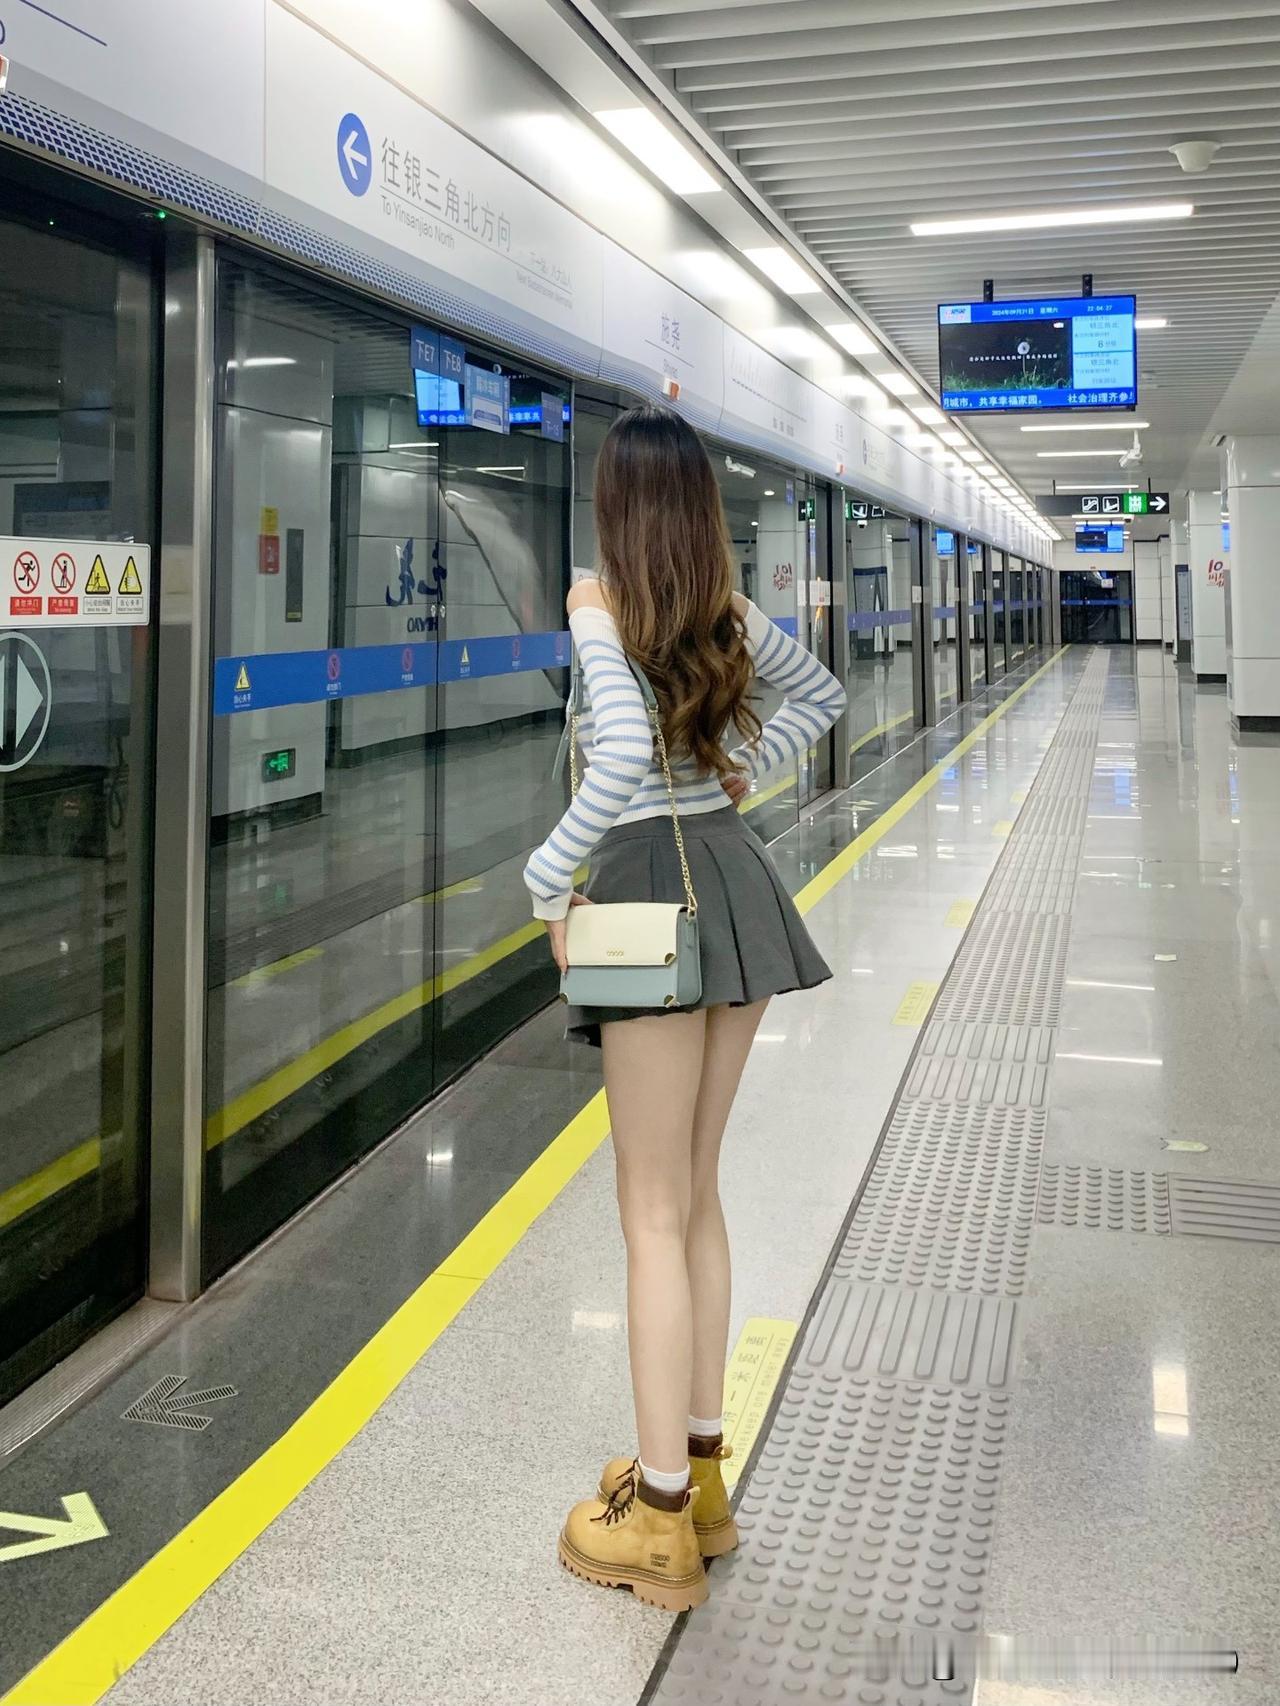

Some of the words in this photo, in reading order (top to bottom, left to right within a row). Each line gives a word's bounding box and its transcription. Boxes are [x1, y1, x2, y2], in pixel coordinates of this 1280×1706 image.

[381, 137, 511, 252] 往银三角北方向
[381, 195, 391, 216] To
[393, 201, 433, 242] Yinsanjiao
[434, 226, 455, 250] North
